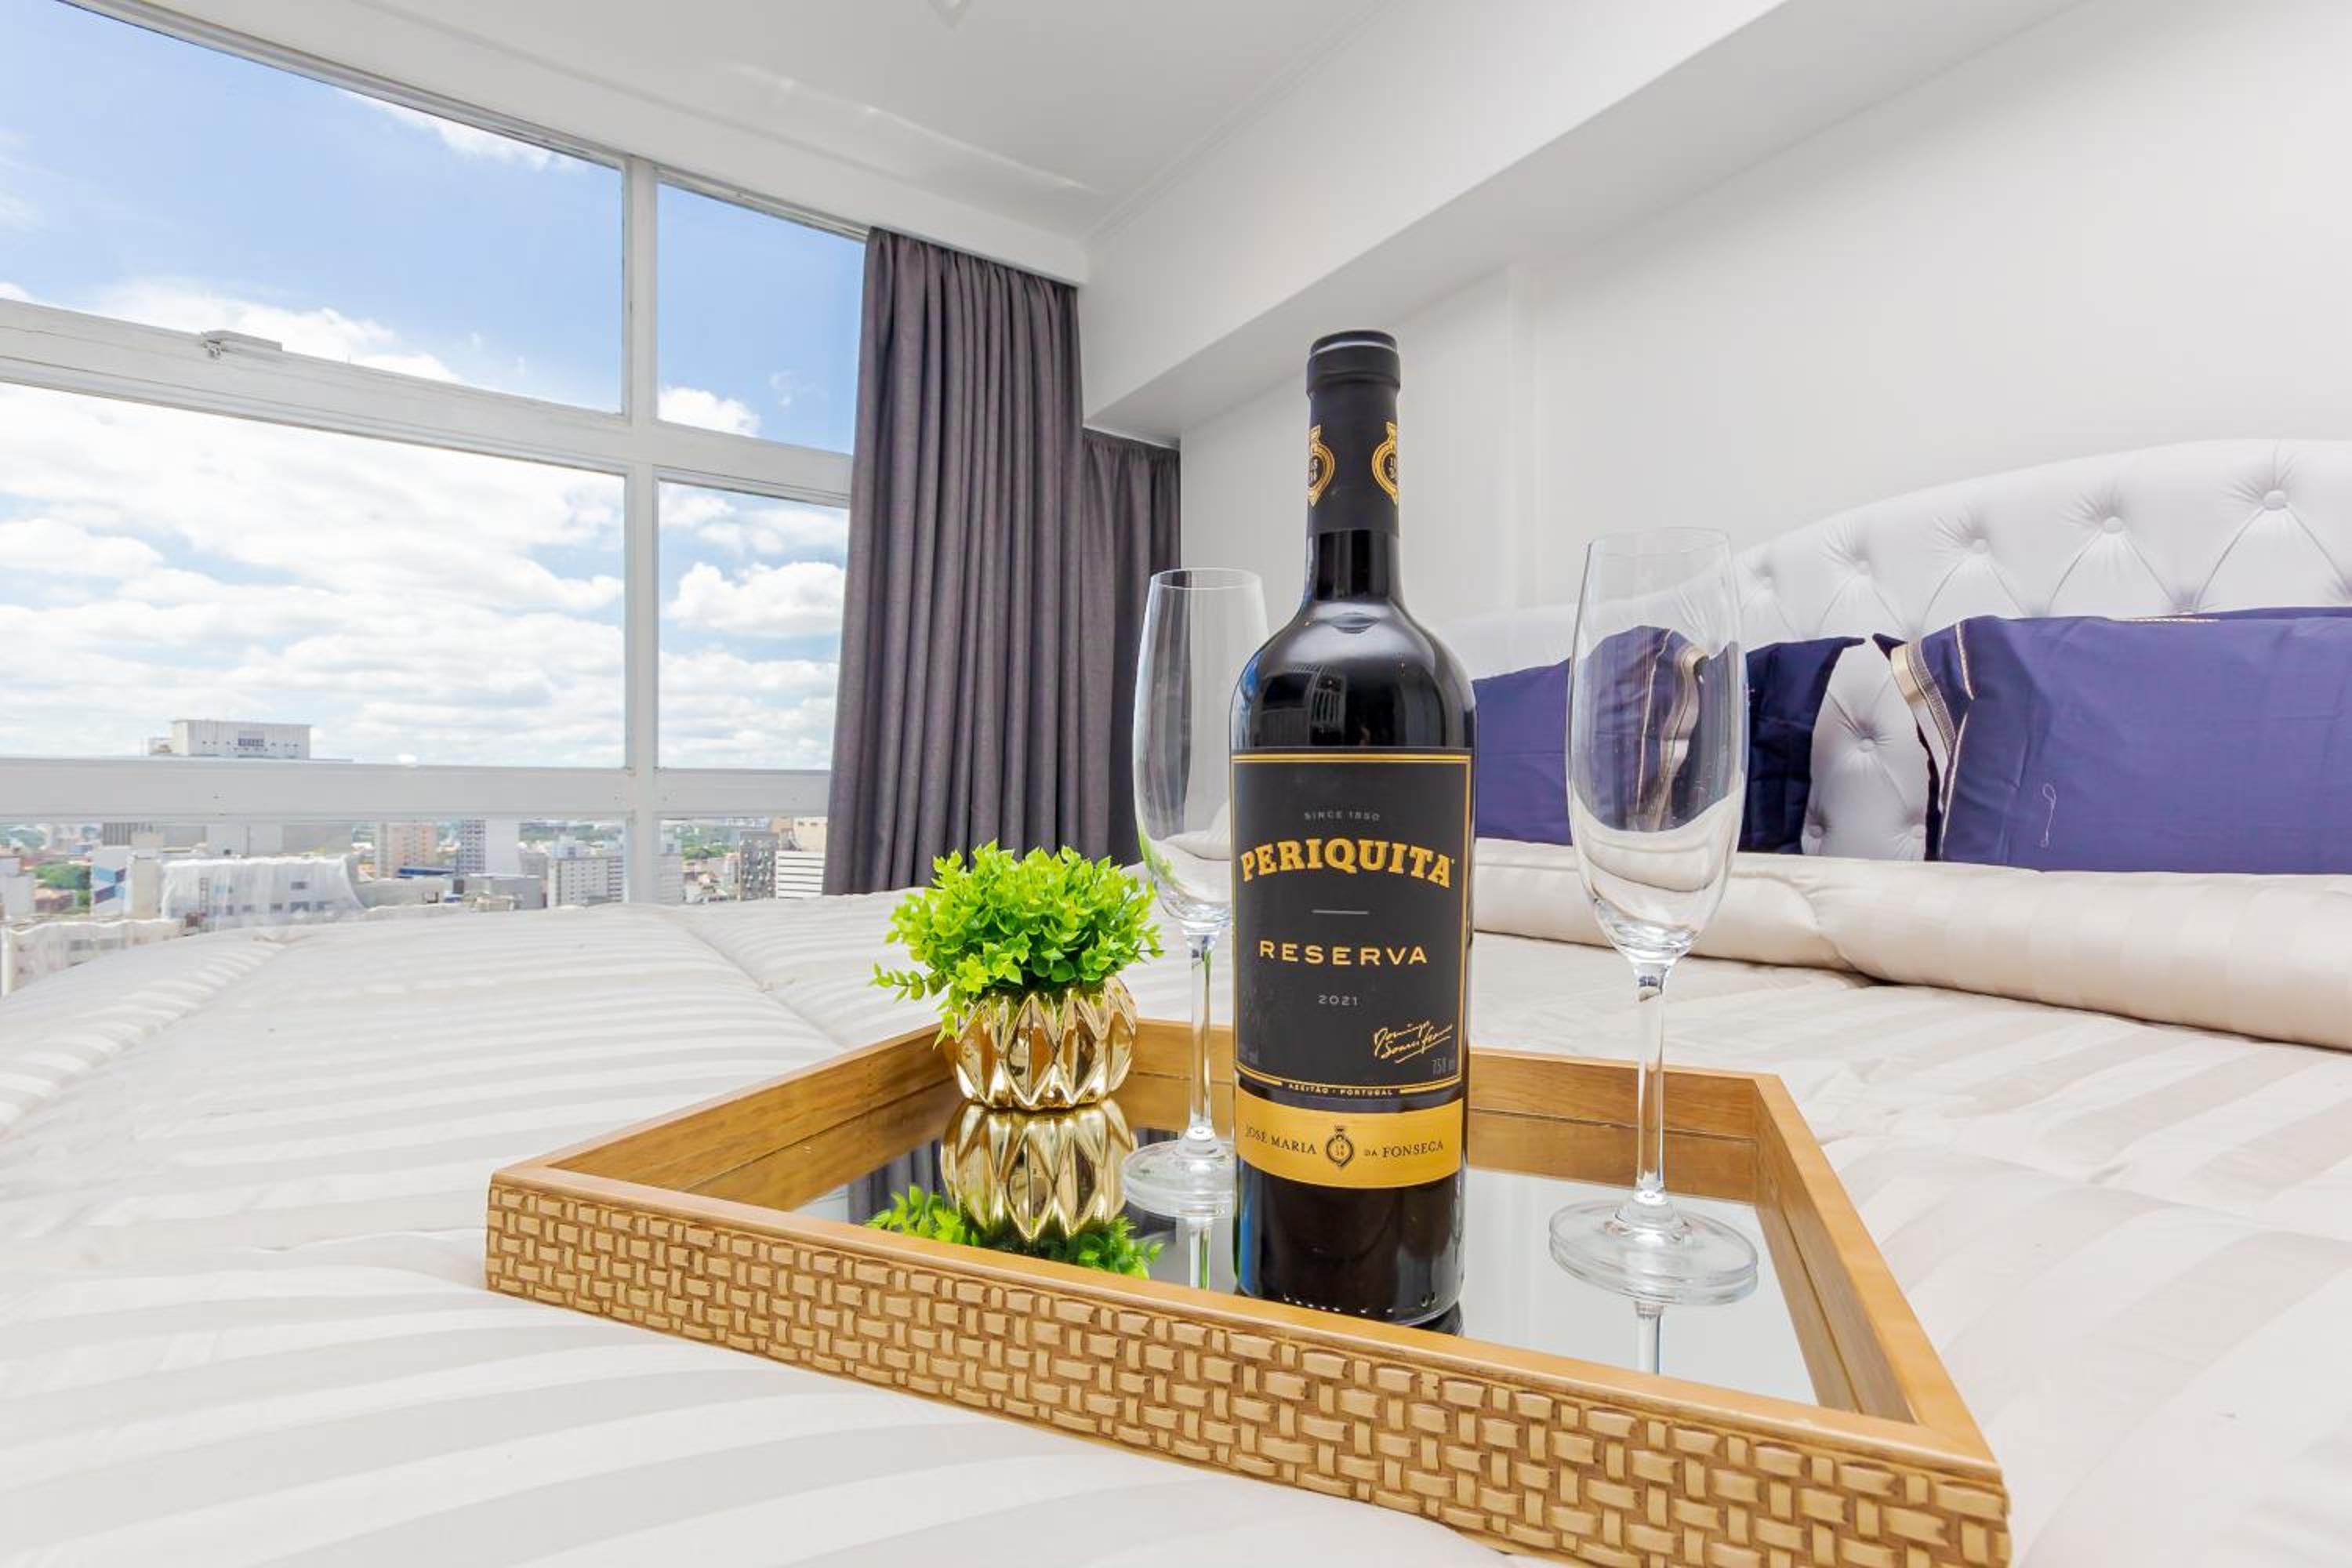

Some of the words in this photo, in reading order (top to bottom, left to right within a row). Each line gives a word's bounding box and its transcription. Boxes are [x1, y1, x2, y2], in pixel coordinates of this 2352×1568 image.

[1304, 810, 1343, 821] SINCE
[1348, 810, 1381, 822] 1850
[1240, 838, 1450, 888] PERIQUITA
[1259, 940, 1428, 966] RESERVA
[1318, 994, 1359, 1007] 2021
[1340, 1088, 1393, 1097] PORTUGAL
[1271, 1134, 1317, 1155] MARIA
[1364, 1149, 1377, 1157] DA
[1382, 1141, 1443, 1159] FONSECA
